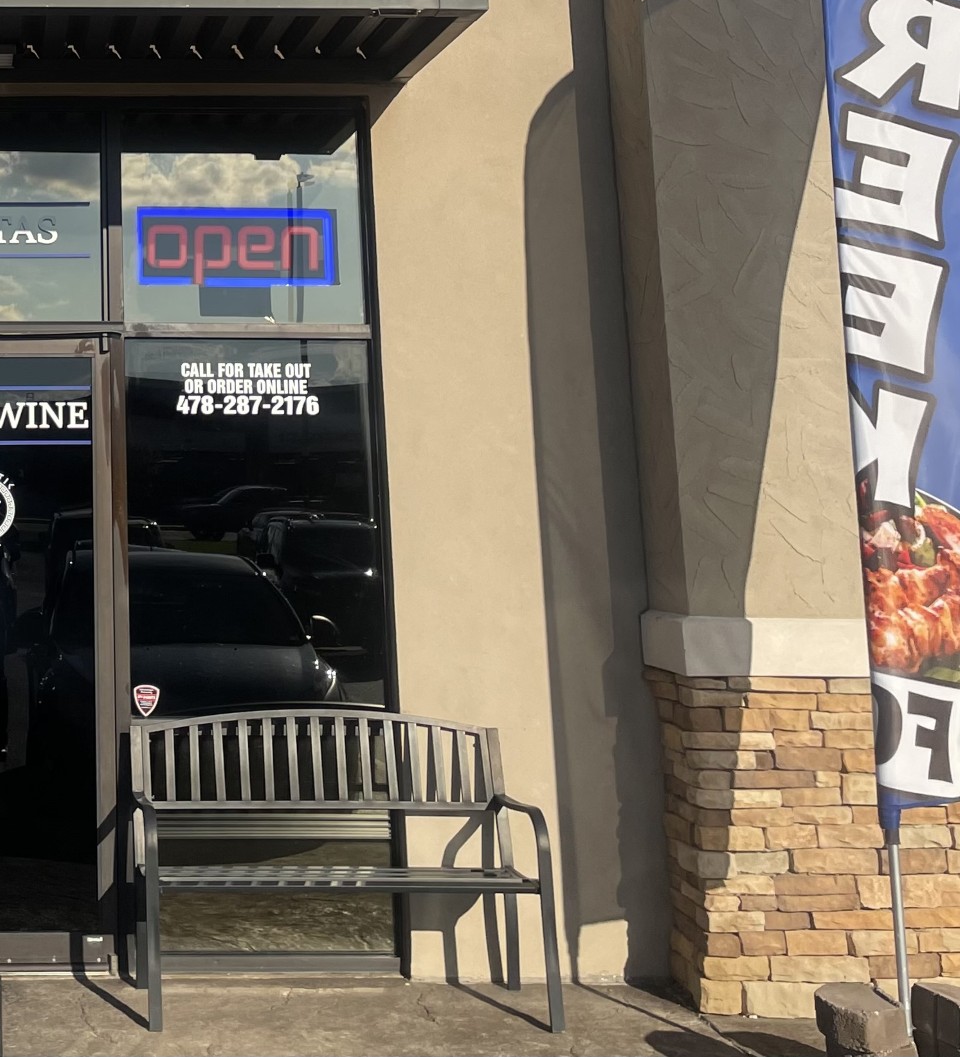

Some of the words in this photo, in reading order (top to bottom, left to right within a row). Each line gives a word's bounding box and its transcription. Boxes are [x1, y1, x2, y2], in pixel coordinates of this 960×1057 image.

[146, 224, 320, 286] open
[180, 362, 215, 378] CALL
[217, 362, 244, 378] FOR
[247, 363, 282, 378] TAKE
[285, 363, 312, 379] OUT
[184, 378, 204, 395] OR
[207, 378, 253, 395] ORDER
[256, 379, 309, 395] ONLINE
[176, 395, 320, 416] 478-287-2176
